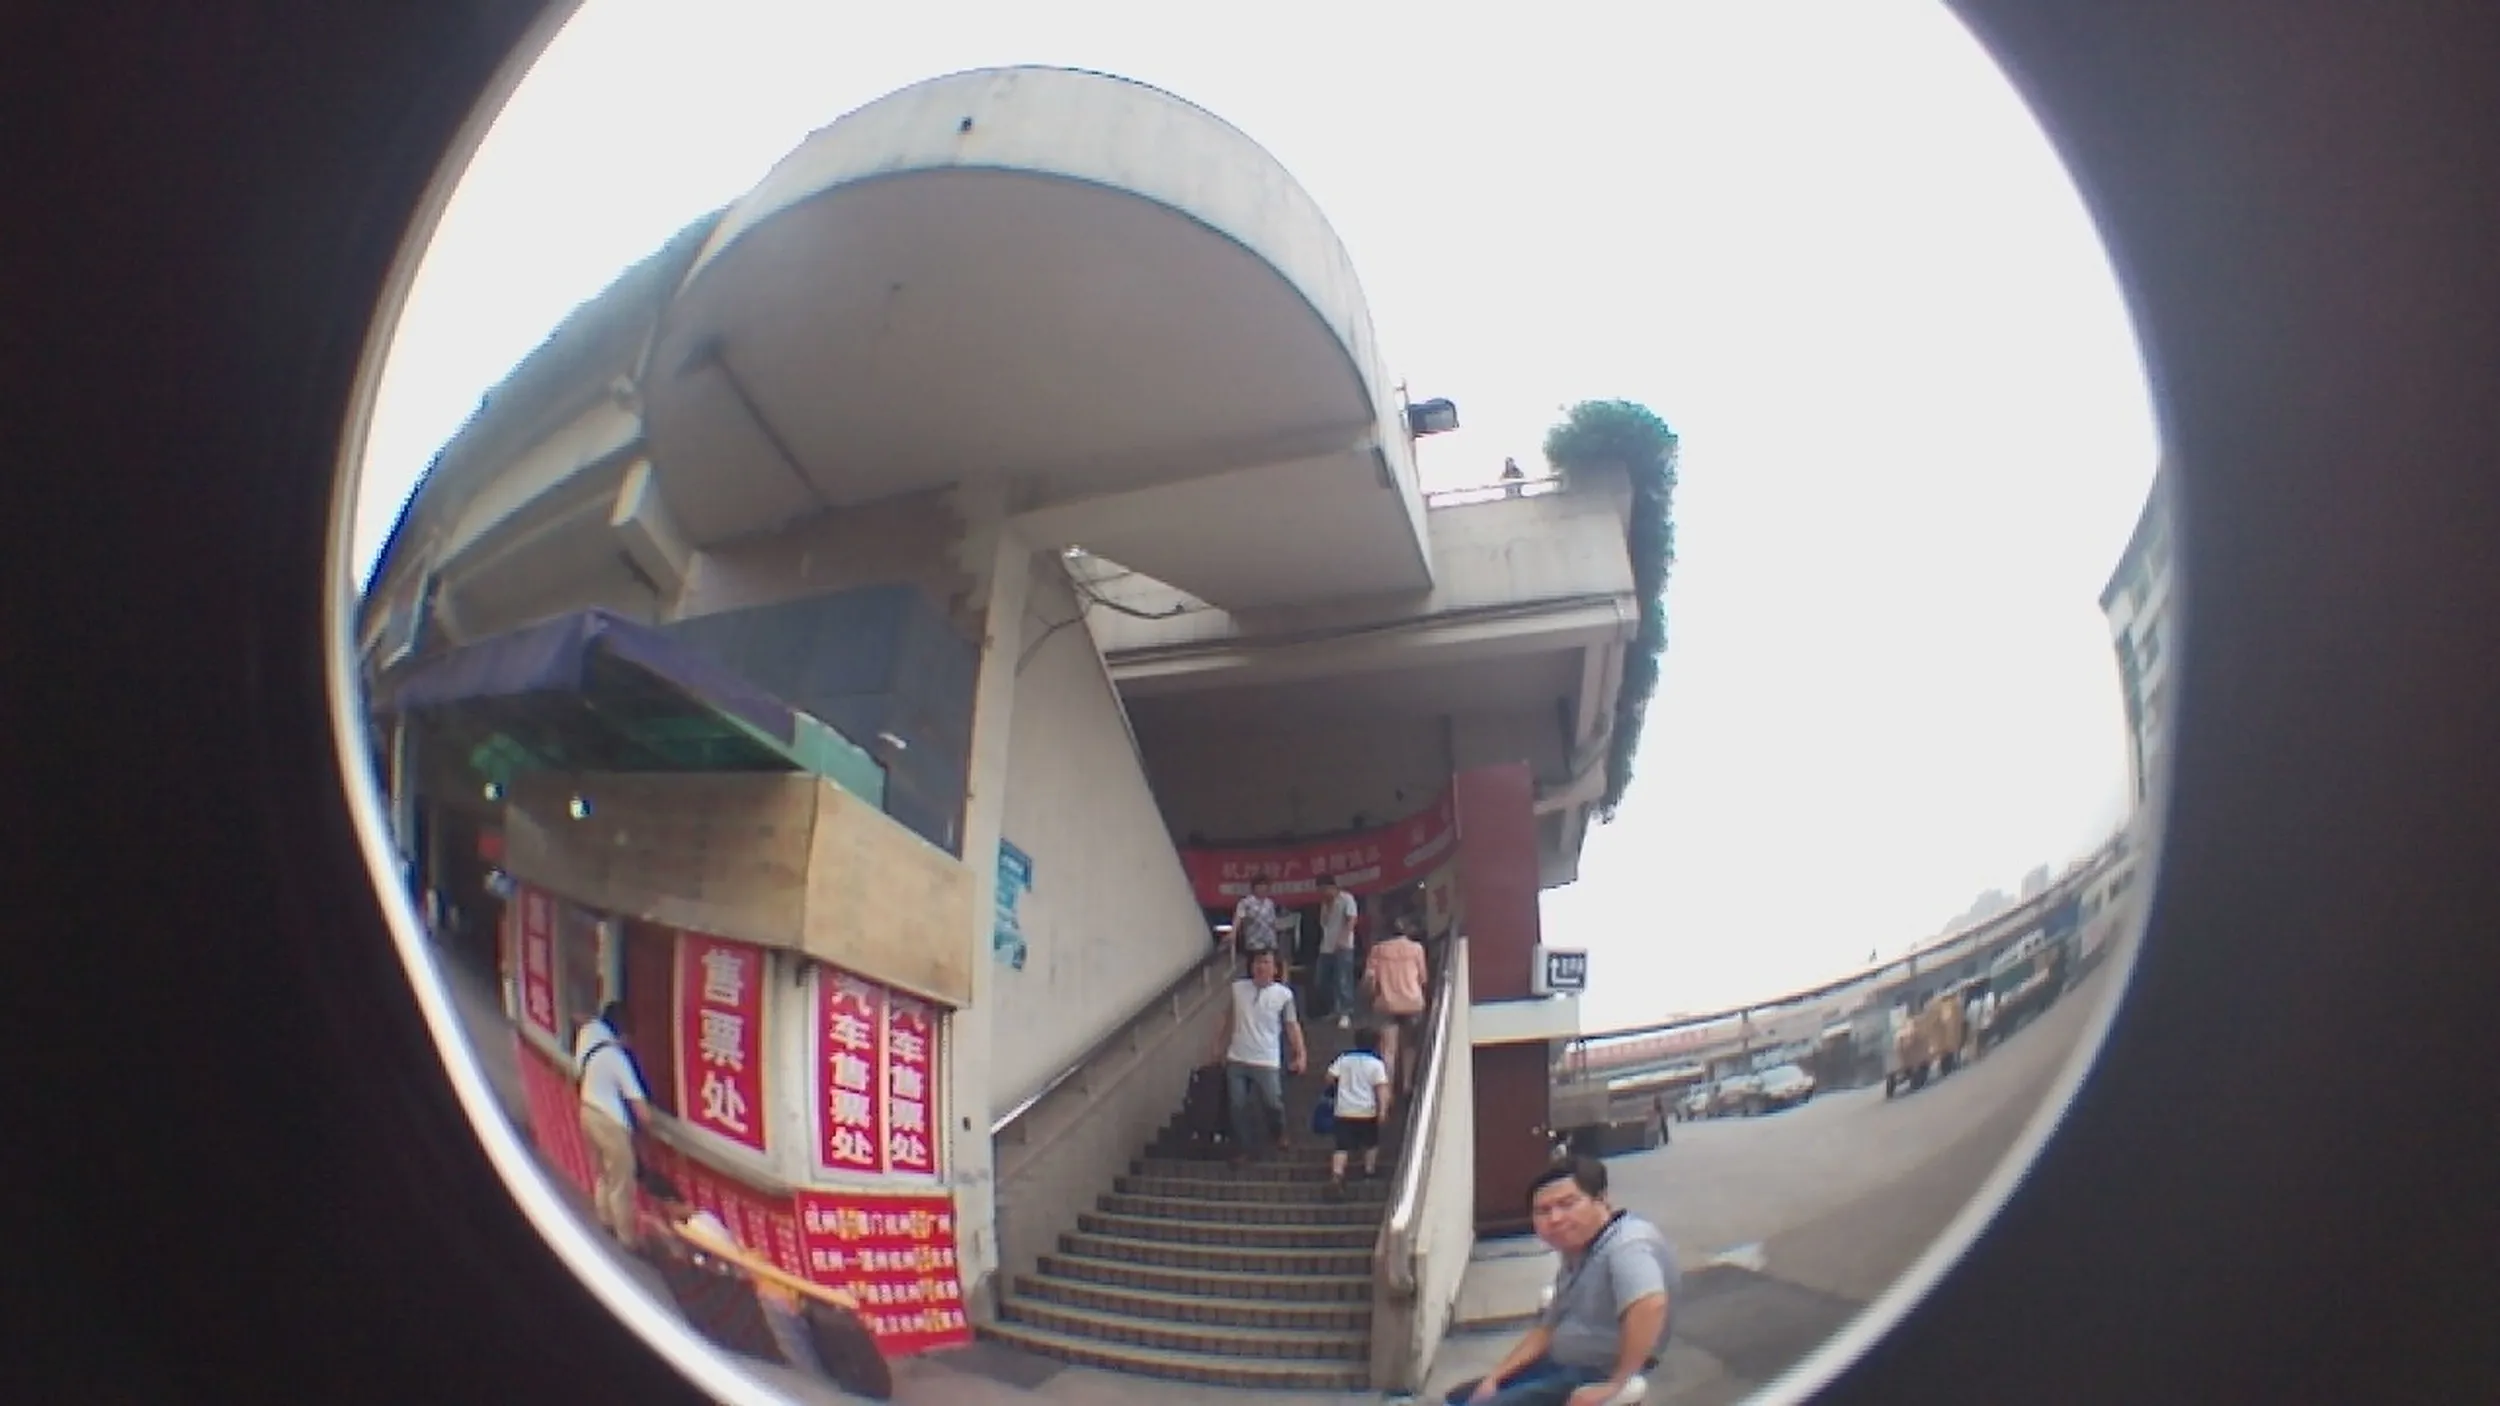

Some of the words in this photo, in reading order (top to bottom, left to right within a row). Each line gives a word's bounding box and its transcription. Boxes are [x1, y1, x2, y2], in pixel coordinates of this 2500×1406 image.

[701, 948, 748, 1133] 售票处
[829, 974, 874, 1166] 汽车售票处
[890, 996, 927, 1167] 汽车售票处
